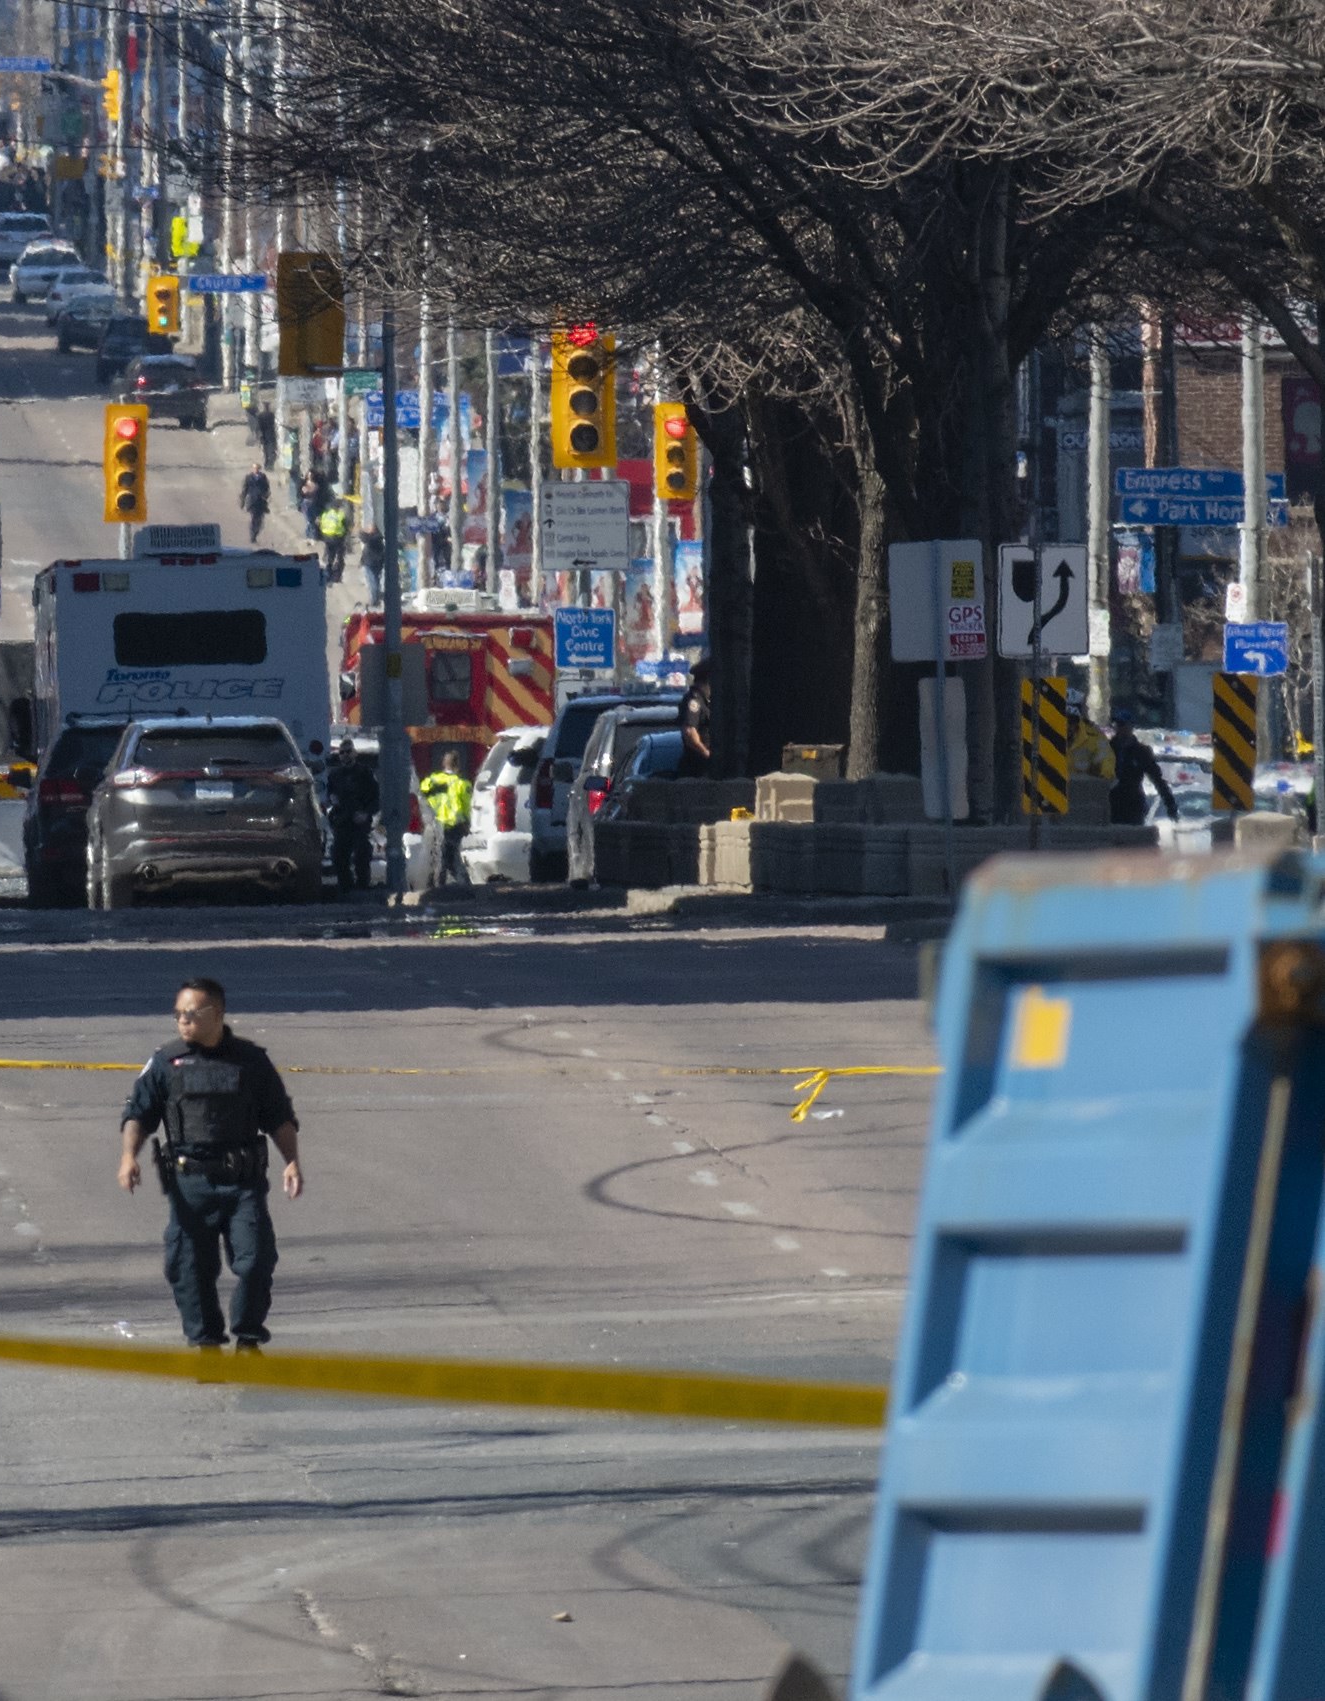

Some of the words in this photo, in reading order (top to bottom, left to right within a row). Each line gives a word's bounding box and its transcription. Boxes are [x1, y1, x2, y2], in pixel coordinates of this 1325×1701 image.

[1124, 471, 1202, 491] Empress
[1158, 501, 1200, 520] Park
[1205, 502, 1245, 521] Hom
[557, 611, 589, 625] North
[949, 606, 982, 623] GPS
[570, 625, 600, 638] Civic
[565, 638, 604, 651] Centre
[107, 669, 170, 681] Toronto
[97, 679, 284, 703] POLICE
